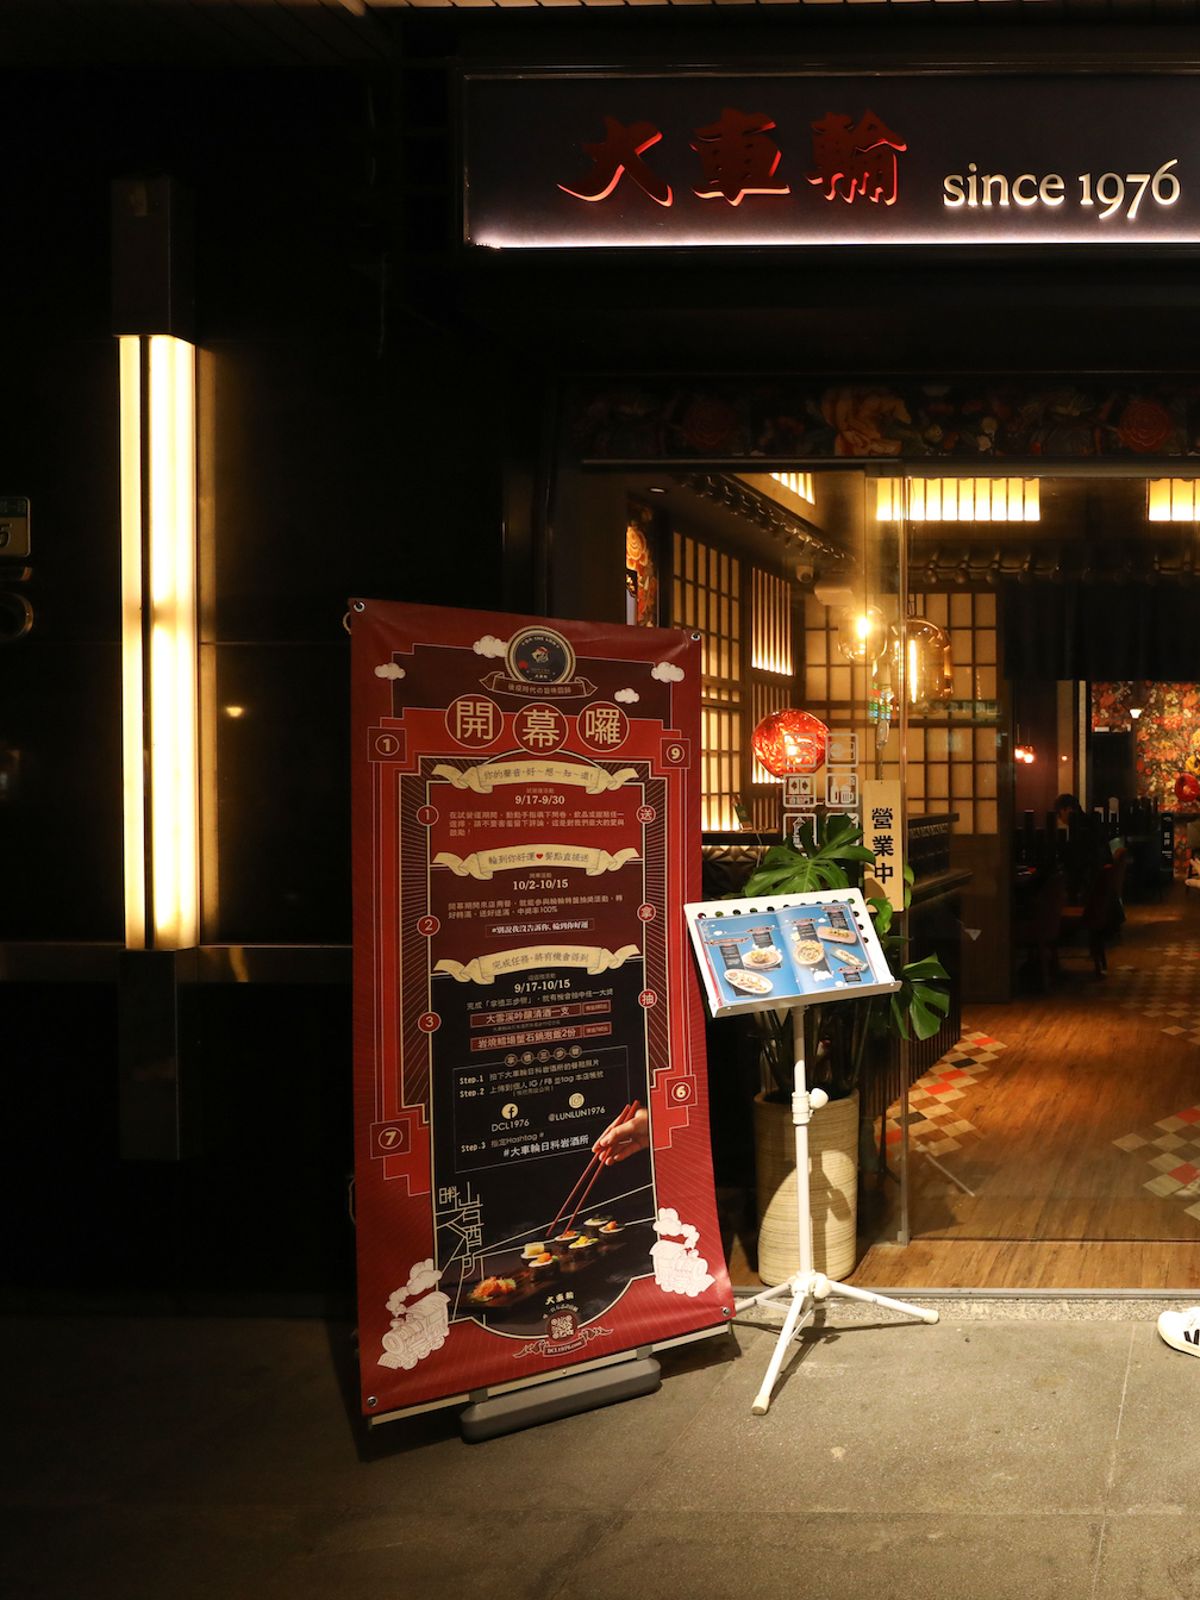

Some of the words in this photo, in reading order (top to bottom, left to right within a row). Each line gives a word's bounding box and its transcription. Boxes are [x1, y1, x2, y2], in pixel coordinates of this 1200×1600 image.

[556, 107, 908, 207] 大車輪
[943, 162, 1066, 209] since
[1077, 158, 1182, 219] 1976
[455, 701, 622, 748] 開幕囉
[382, 738, 391, 752] 1
[670, 747, 681, 760] 9
[514, 795, 565, 806] 9/17-9/30
[871, 807, 894, 885] 營業中
[512, 878, 569, 891] 10/2-10/15
[423, 919, 433, 931] 2
[513, 978, 571, 993] 9/17-10/15
[642, 992, 654, 1005] 抽
[424, 1015, 434, 1028] 3
[459, 1075, 484, 1085] Step.1
[459, 1088, 485, 1098] Step.2
[675, 1084, 687, 1098] 6
[548, 1106, 606, 1122] @LUNLUN1976
[491, 1119, 530, 1132] DCL1976
[384, 1131, 398, 1146] 7
[460, 1141, 486, 1153] Step.3
